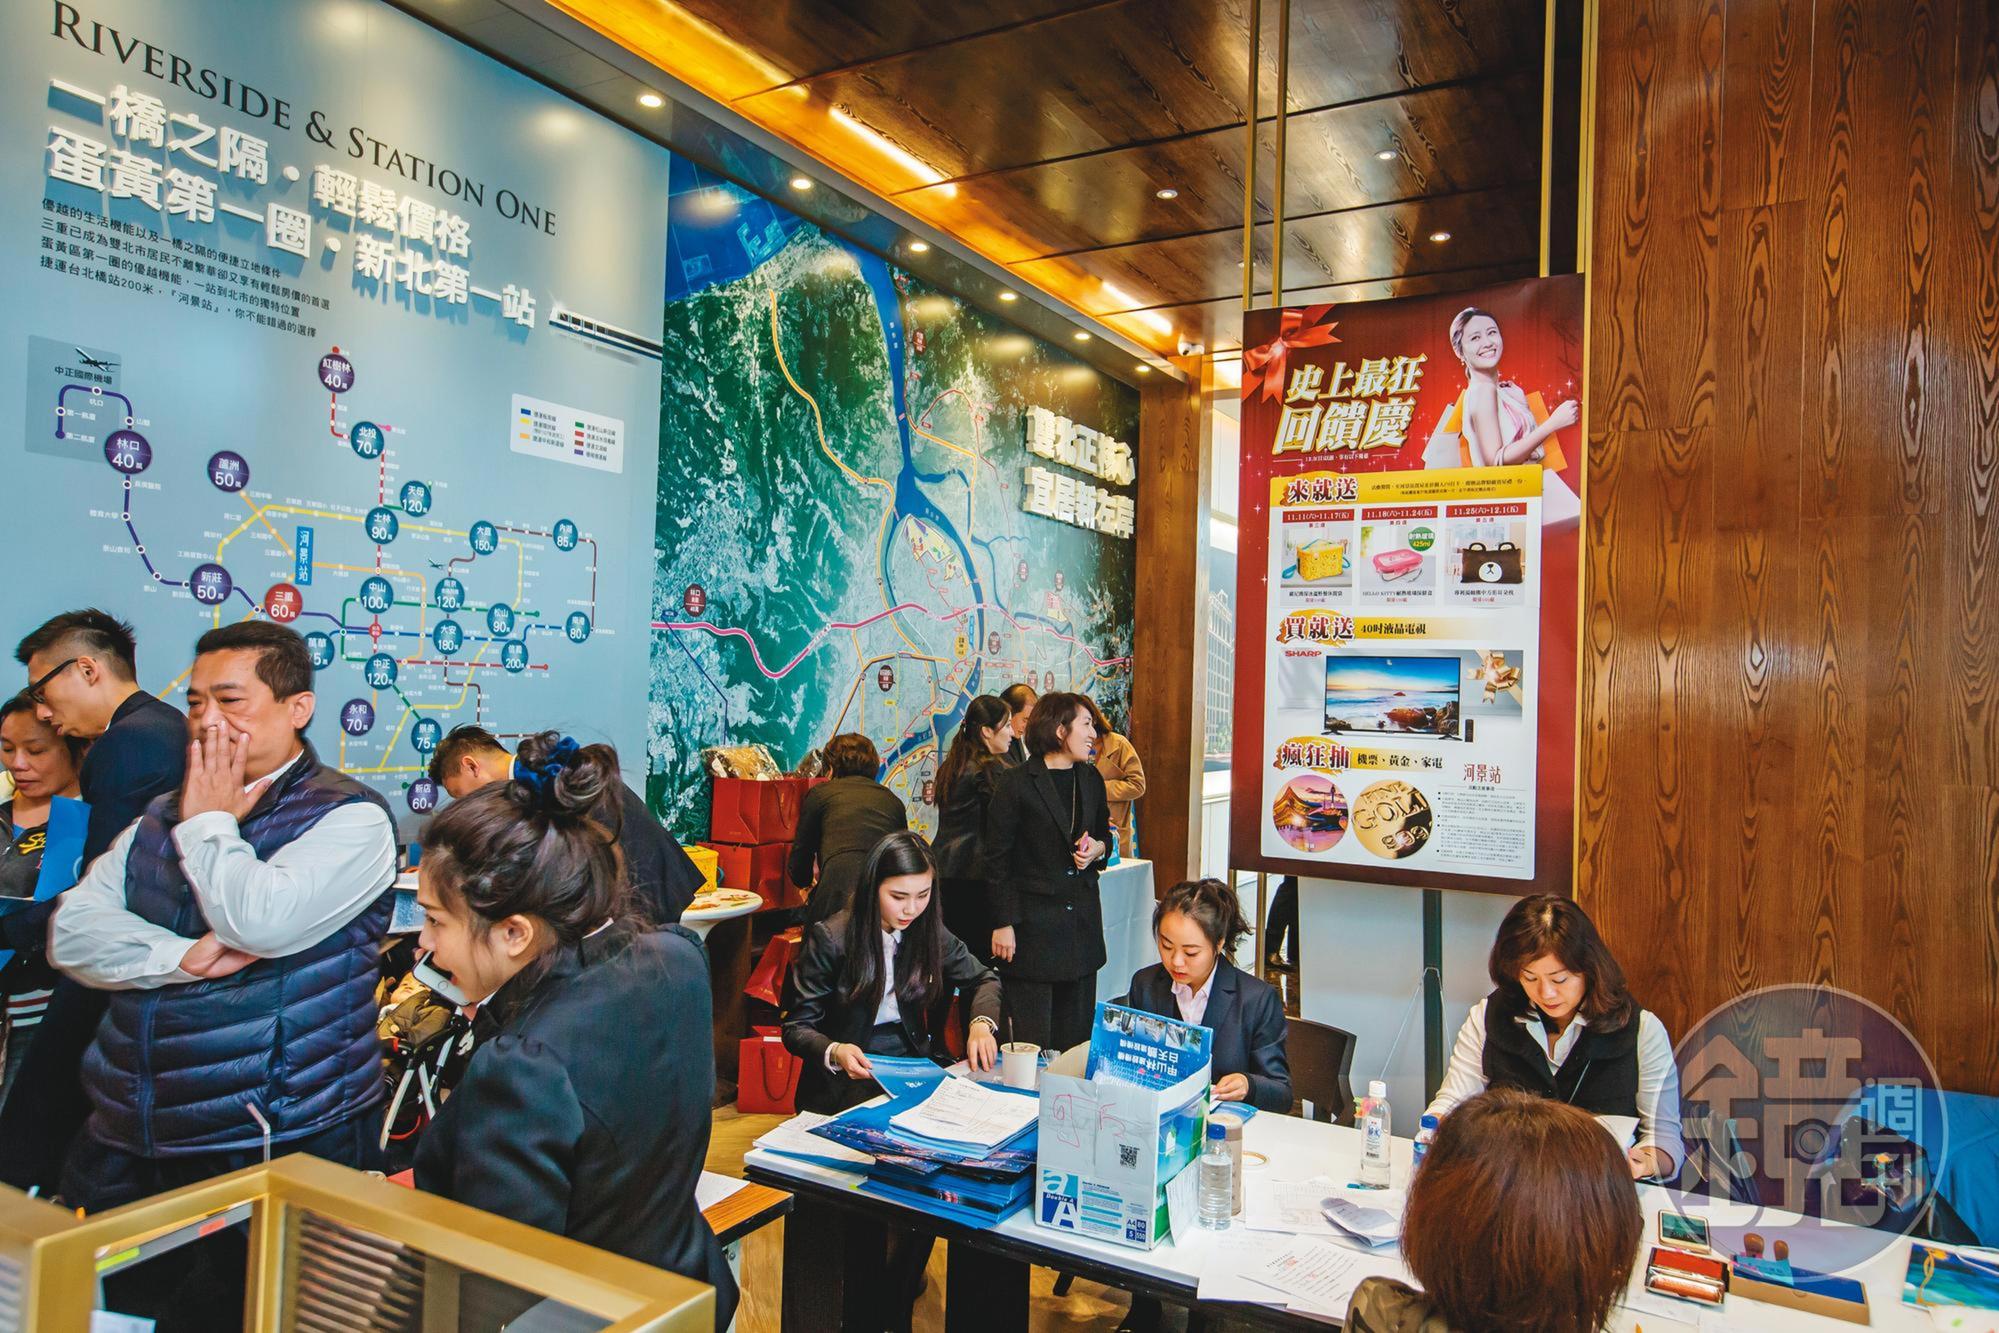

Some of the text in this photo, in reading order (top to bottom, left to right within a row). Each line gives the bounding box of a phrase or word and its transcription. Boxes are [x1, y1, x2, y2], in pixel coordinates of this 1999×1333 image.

[51, 0, 557, 237] RIVERSIDE & STATION ONE
[323, 358, 351, 373] 紅樹林
[54, 365, 113, 385] 中正國際機場
[1285, 353, 1428, 404] 史上最狂
[358, 426, 377, 439] 北投
[1272, 396, 1416, 456] 回饋慶
[117, 437, 140, 451] 林口
[218, 457, 240, 471] 蘆洲
[407, 485, 424, 497] 天母
[1288, 477, 1358, 503] 來就送
[374, 512, 391, 523] 士林
[298, 530, 310, 582] 河景站
[369, 582, 387, 592] 中山
[275, 591, 294, 602] 三重
[440, 625, 457, 635] 大安
[1285, 615, 1354, 641] 買就送
[1361, 622, 1427, 635] 40吋液晶電視
[372, 659, 391, 669] 中正
[348, 704, 368, 715] 永和
[1281, 743, 1351, 769] 瘋狂抽
[1463, 762, 1501, 784] 河景站
[1045, 1193, 1068, 1203] Double
[1127, 1219, 1136, 1227] A4
